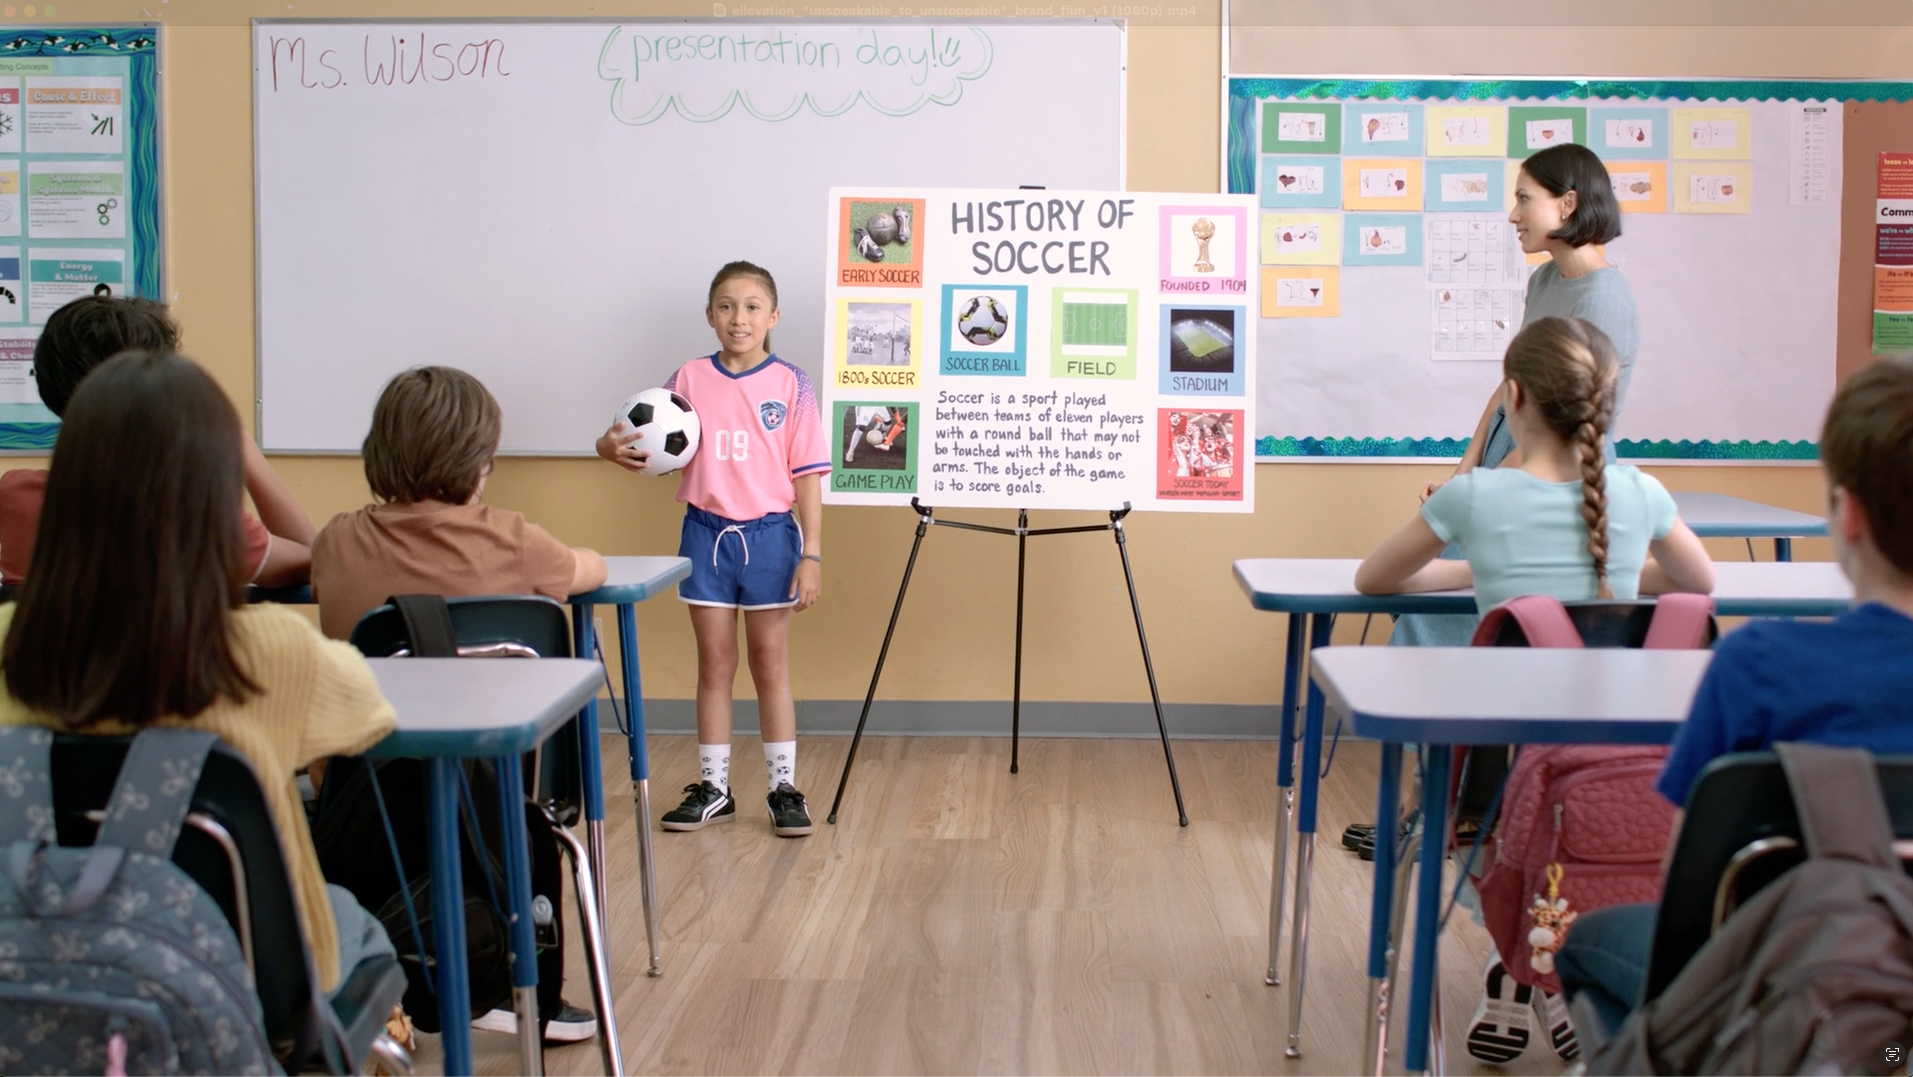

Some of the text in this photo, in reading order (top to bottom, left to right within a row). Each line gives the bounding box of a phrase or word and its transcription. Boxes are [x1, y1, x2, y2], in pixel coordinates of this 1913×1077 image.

[270, 32, 510, 92] Ms. Wilson
[632, 29, 939, 87] presentation day!
[15, 62, 49, 72] Concepts
[68, 91, 78, 102] &
[952, 199, 1134, 234] HISTORY OF
[972, 240, 1111, 276] SOCCER
[59, 262, 93, 272] Energy
[54, 273, 99, 283] & Matter
[842, 269, 920, 284] EARLY SOCCER
[1160, 279, 1247, 292] FOUNDED 1904
[1, 352, 8, 361] &
[945, 357, 1021, 372] SOCCER BALL
[1067, 361, 1117, 375] FIELD
[838, 371, 915, 386] 1800s SOCCER
[1172, 376, 1228, 392] STADIUM
[938, 390, 1106, 410] Soccer is a sport played
[935, 407, 1144, 429] between teams of eleven players
[935, 426, 1141, 446] with a round ball that may not
[715, 430, 748, 461] 09
[935, 441, 1123, 461] be touched with the hands or
[932, 461, 1126, 482] arms. The object of the game
[835, 474, 914, 490] GAME PLAY
[934, 478, 1045, 496] is to score goals.
[1174, 479, 1229, 489] SOCCER TODAY
